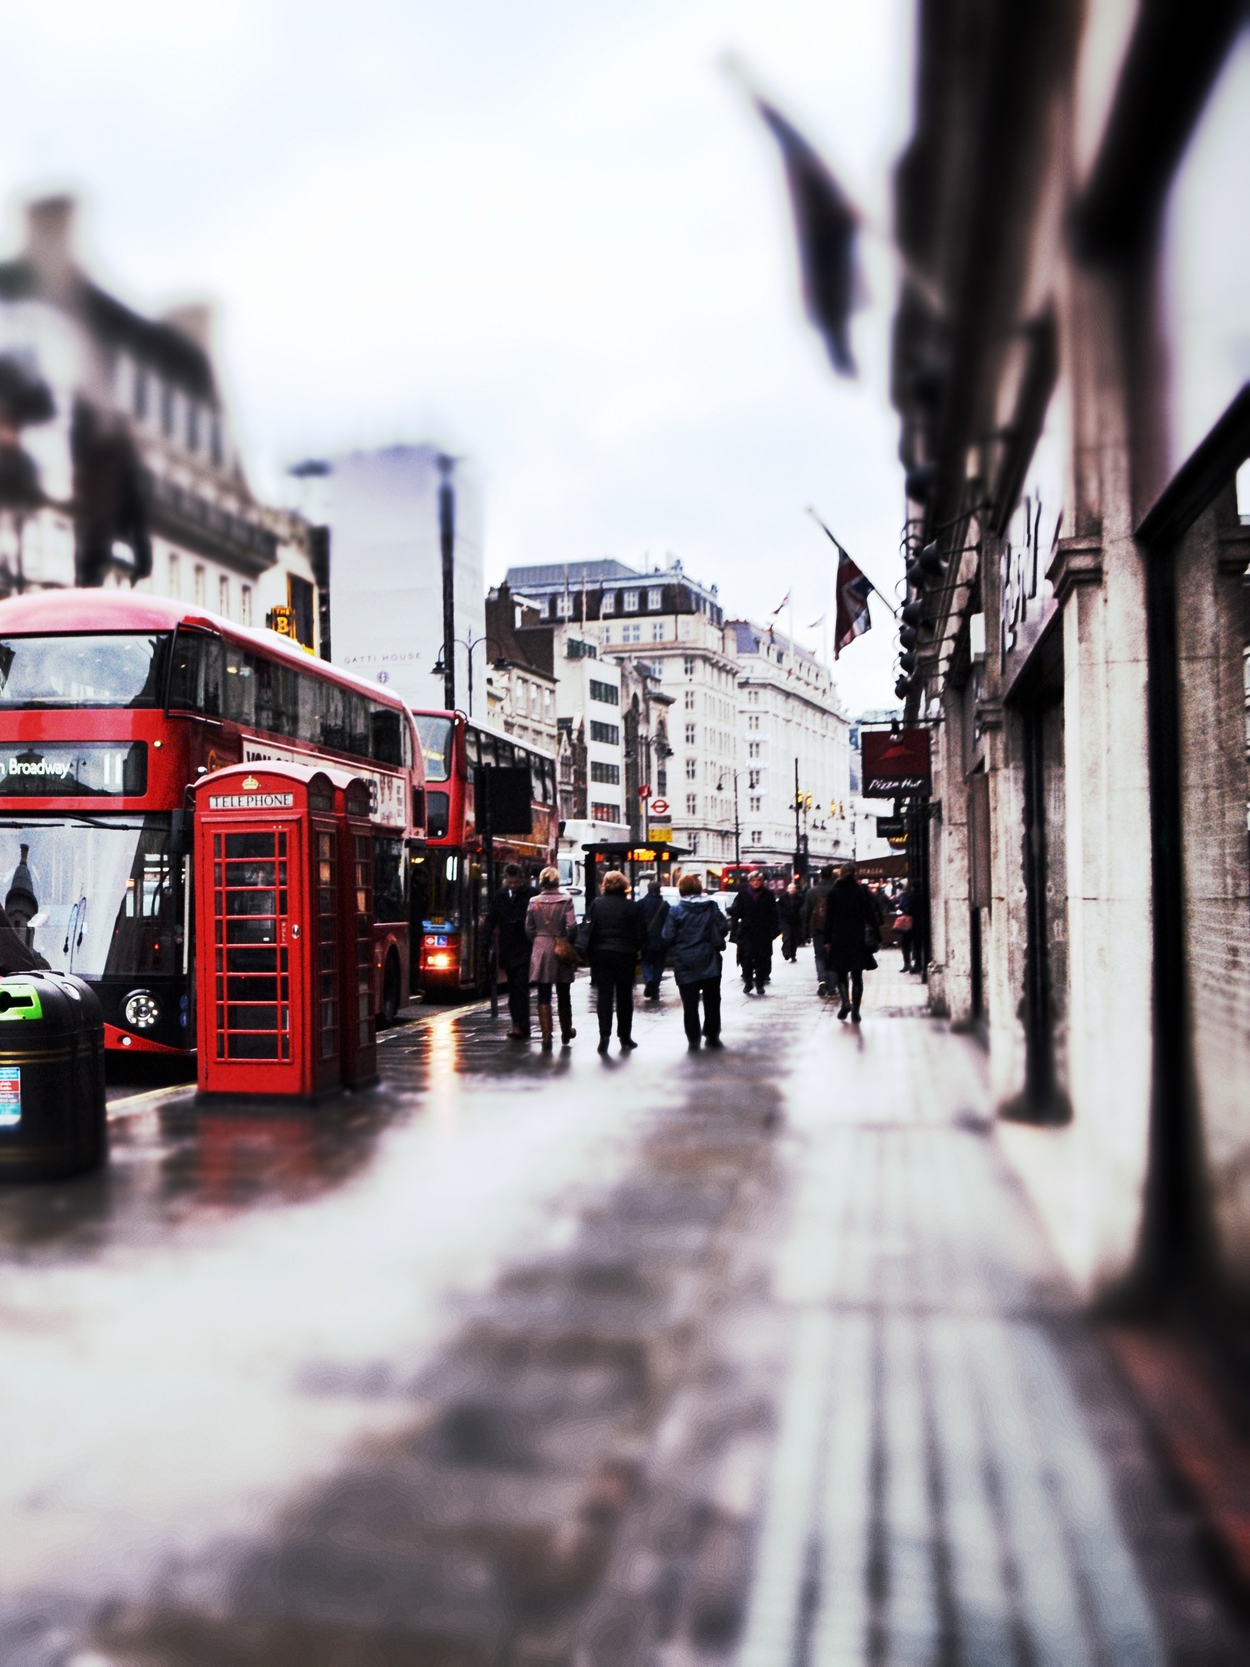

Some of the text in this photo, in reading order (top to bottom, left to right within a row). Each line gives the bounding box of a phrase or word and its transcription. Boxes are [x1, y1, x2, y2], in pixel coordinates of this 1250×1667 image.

[276, 616, 290, 633] B
[343, 651, 422, 664] GATTI HOUSE
[8, 757, 71, 779] Broadway
[103, 752, 124, 785] 11
[868, 778, 924, 791] Pizza Hut
[213, 793, 291, 808] TELEPHONE
